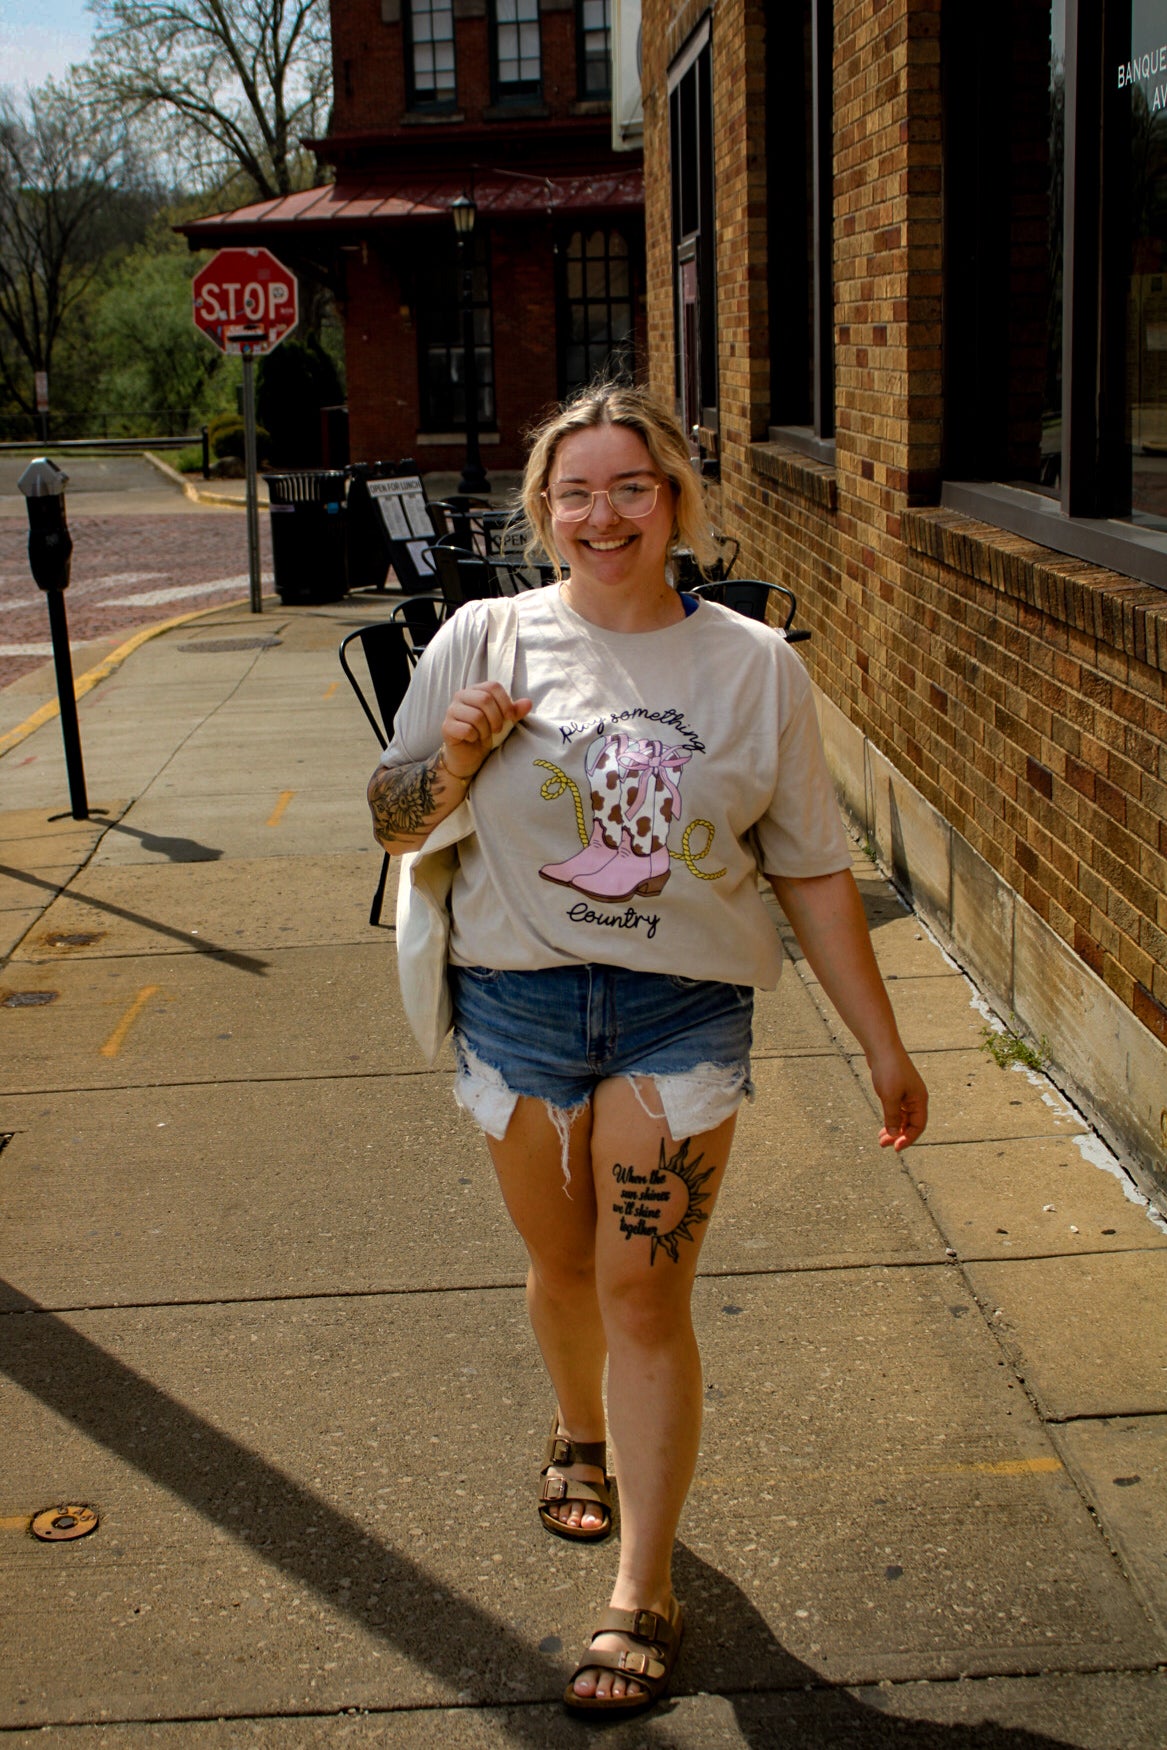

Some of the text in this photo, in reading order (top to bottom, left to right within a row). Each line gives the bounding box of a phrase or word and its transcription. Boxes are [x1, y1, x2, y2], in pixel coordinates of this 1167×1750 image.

[1117, 45, 1167, 89] BANQUE
[200, 282, 289, 321] STOP
[370, 480, 421, 494] OPEN FOR LUNCH
[610, 707, 706, 754] something
[612, 1163, 666, 1184] When the
